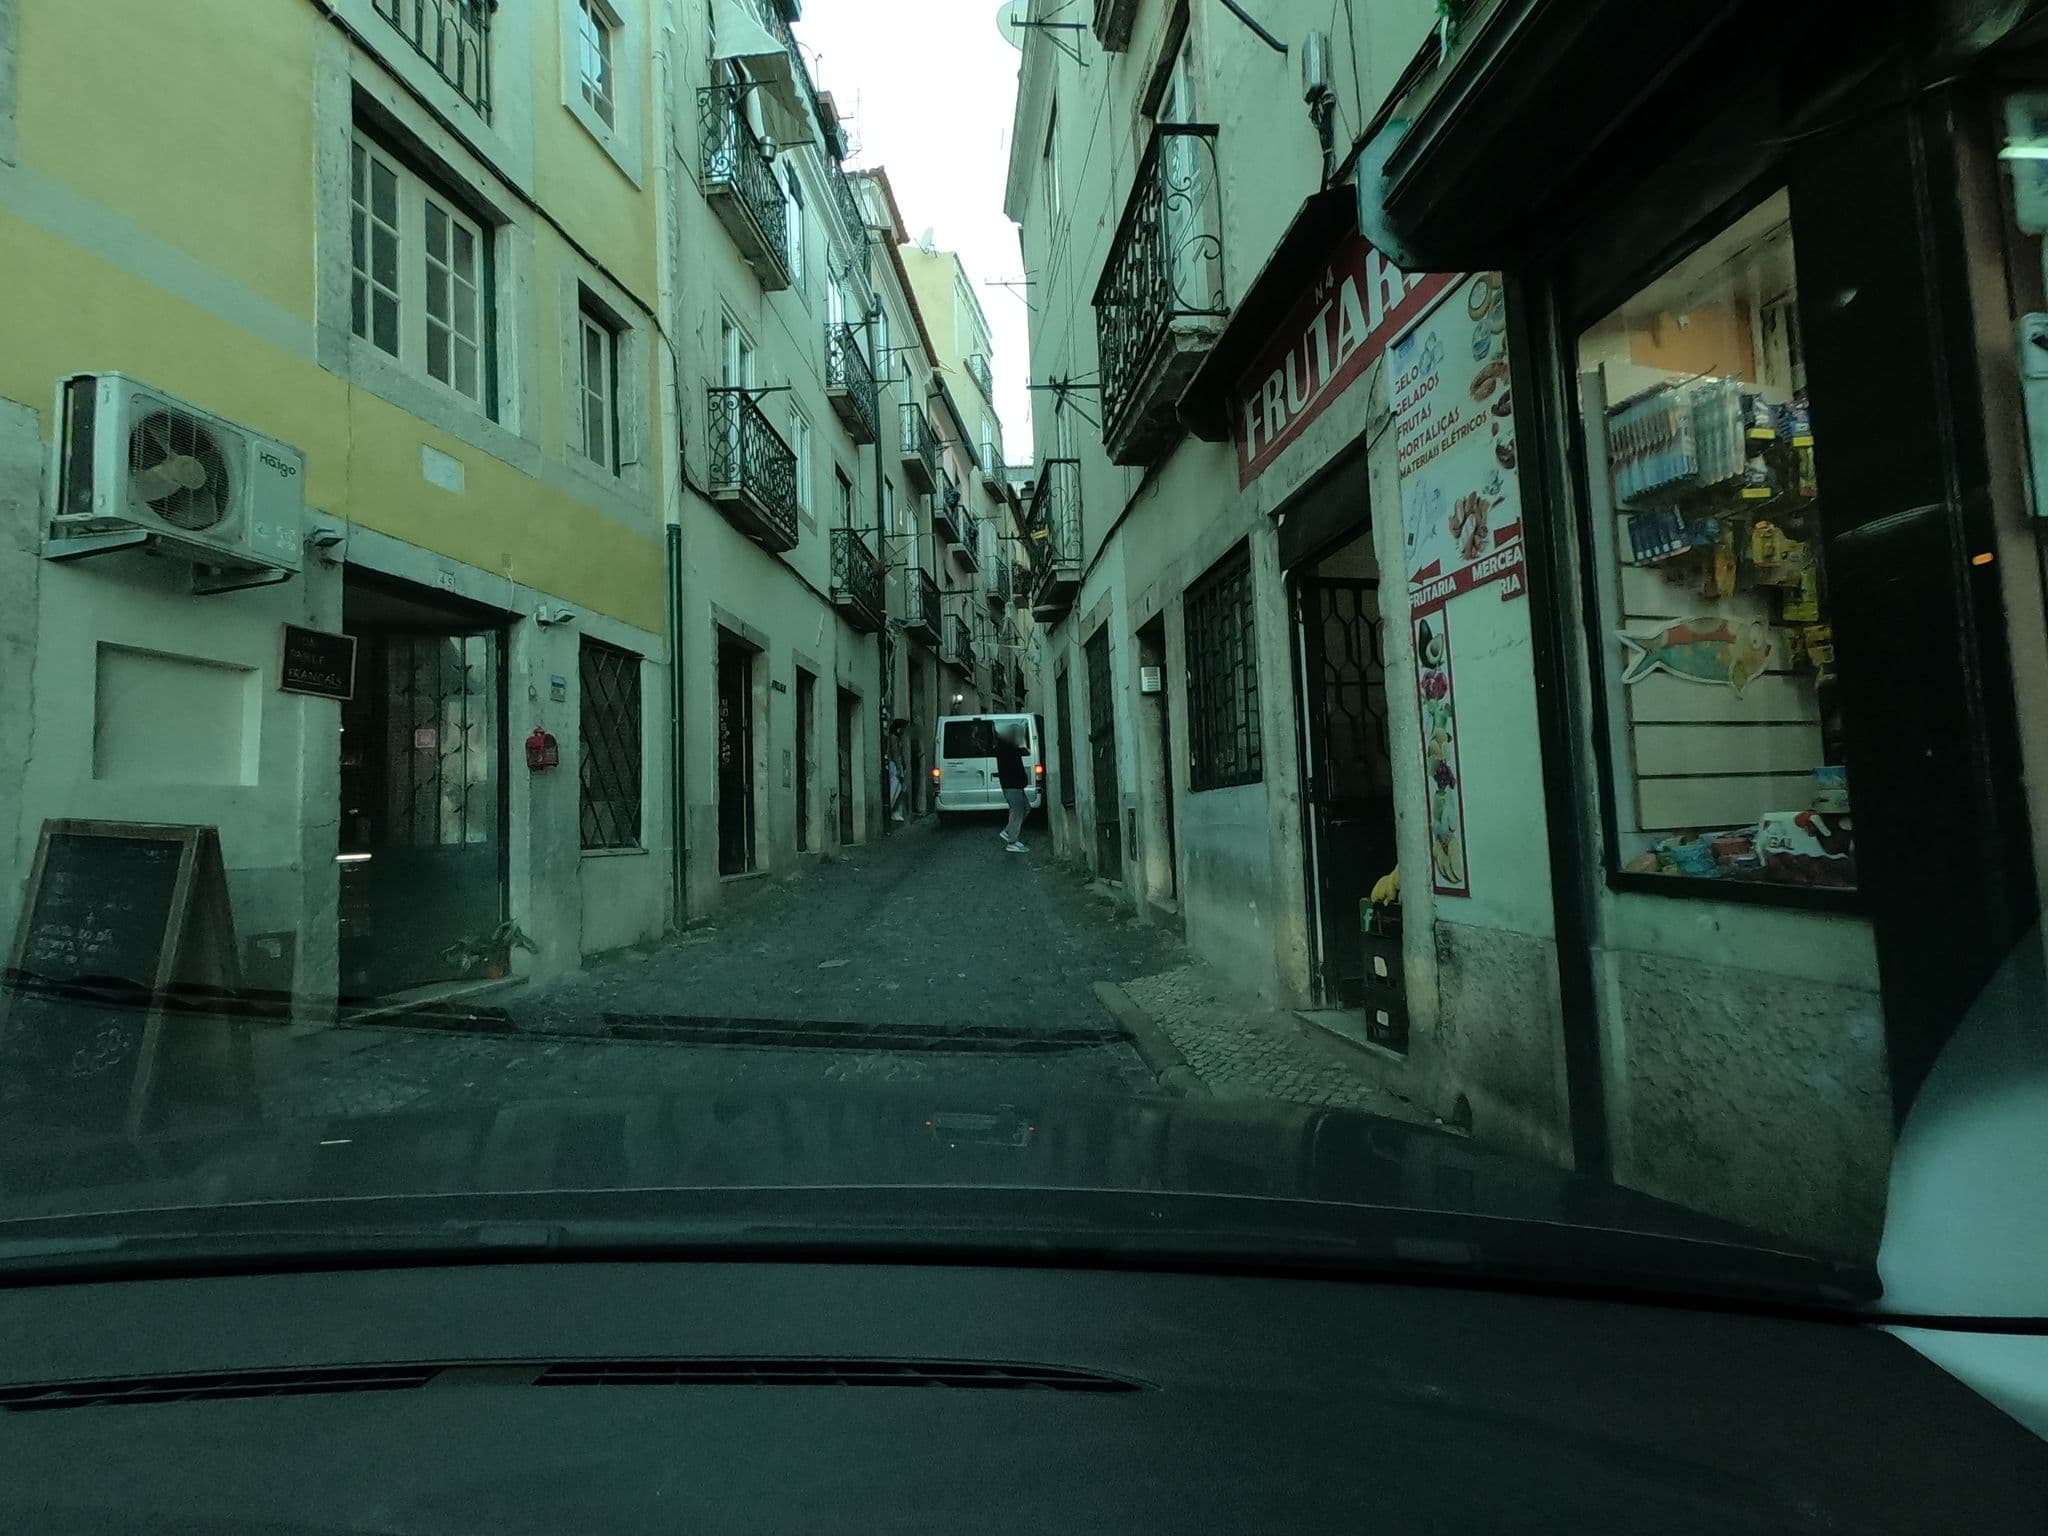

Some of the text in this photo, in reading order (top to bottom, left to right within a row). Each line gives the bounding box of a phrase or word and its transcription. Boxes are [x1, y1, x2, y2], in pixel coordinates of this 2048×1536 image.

[1244, 247, 1428, 463] FRUTAR
[1397, 402, 1432, 440] FRUTAS
[1400, 406, 1460, 462] HORTALIÇAS
[1400, 410, 1487, 480] MATERIAIS ELÉTRICOS
[1409, 545, 1523, 608] FRUTARIA MERCEA
[1500, 573, 1521, 597] RIA
